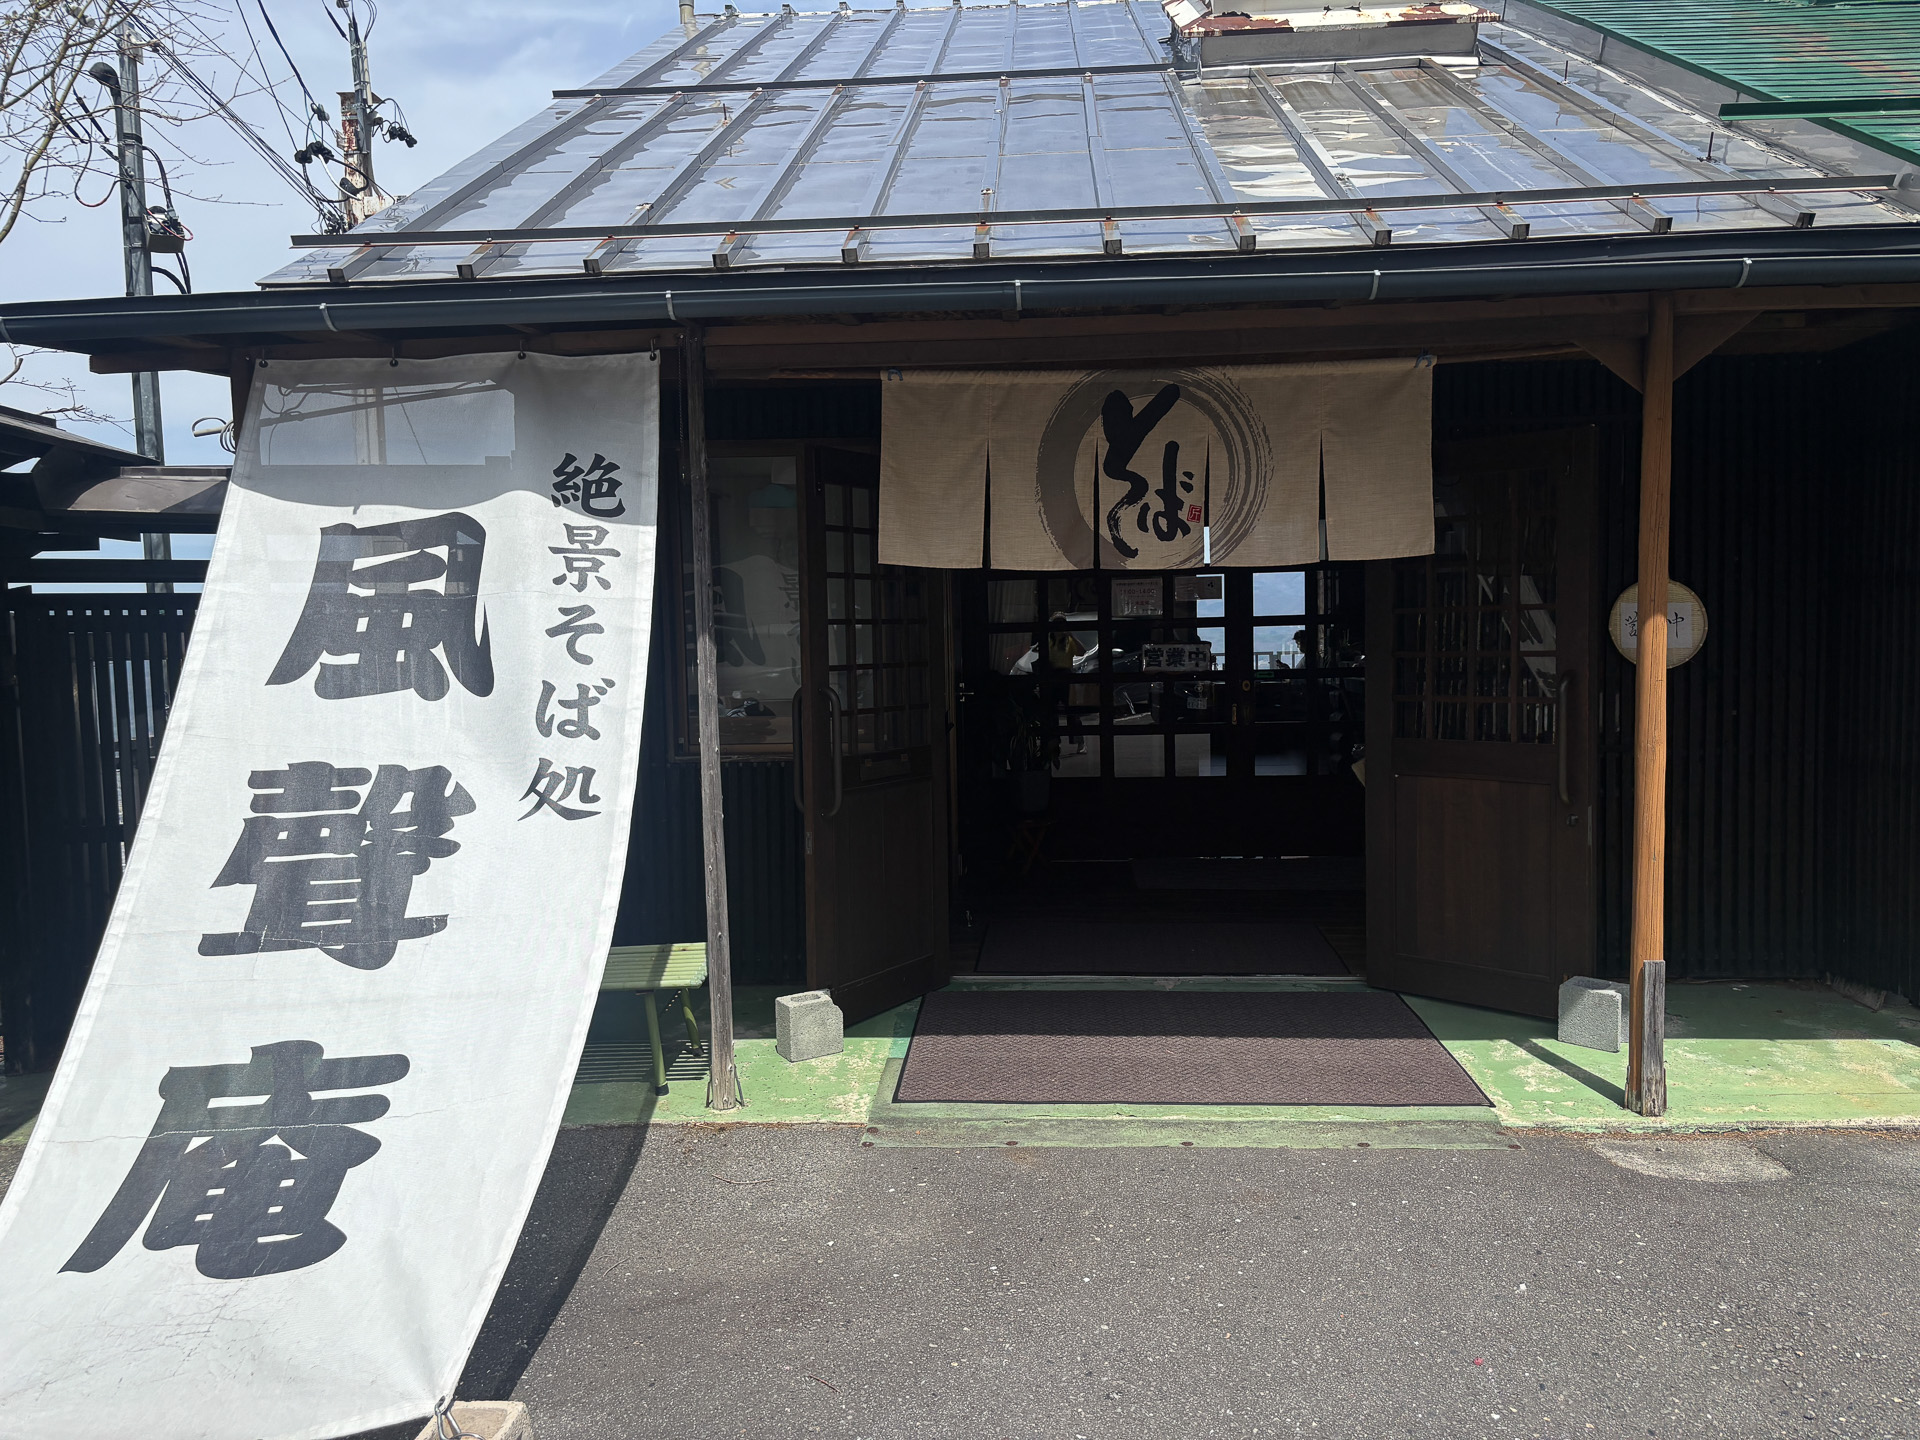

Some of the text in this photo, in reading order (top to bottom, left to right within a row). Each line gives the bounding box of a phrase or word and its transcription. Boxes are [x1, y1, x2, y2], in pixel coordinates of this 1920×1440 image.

[1101, 383, 1194, 558] そば
[518, 452, 625, 822] 絶景そば処
[1144, 647, 1207, 668] 営業中
[1625, 610, 1685, 639] 営中
[57, 511, 494, 1279] 風聲庵
